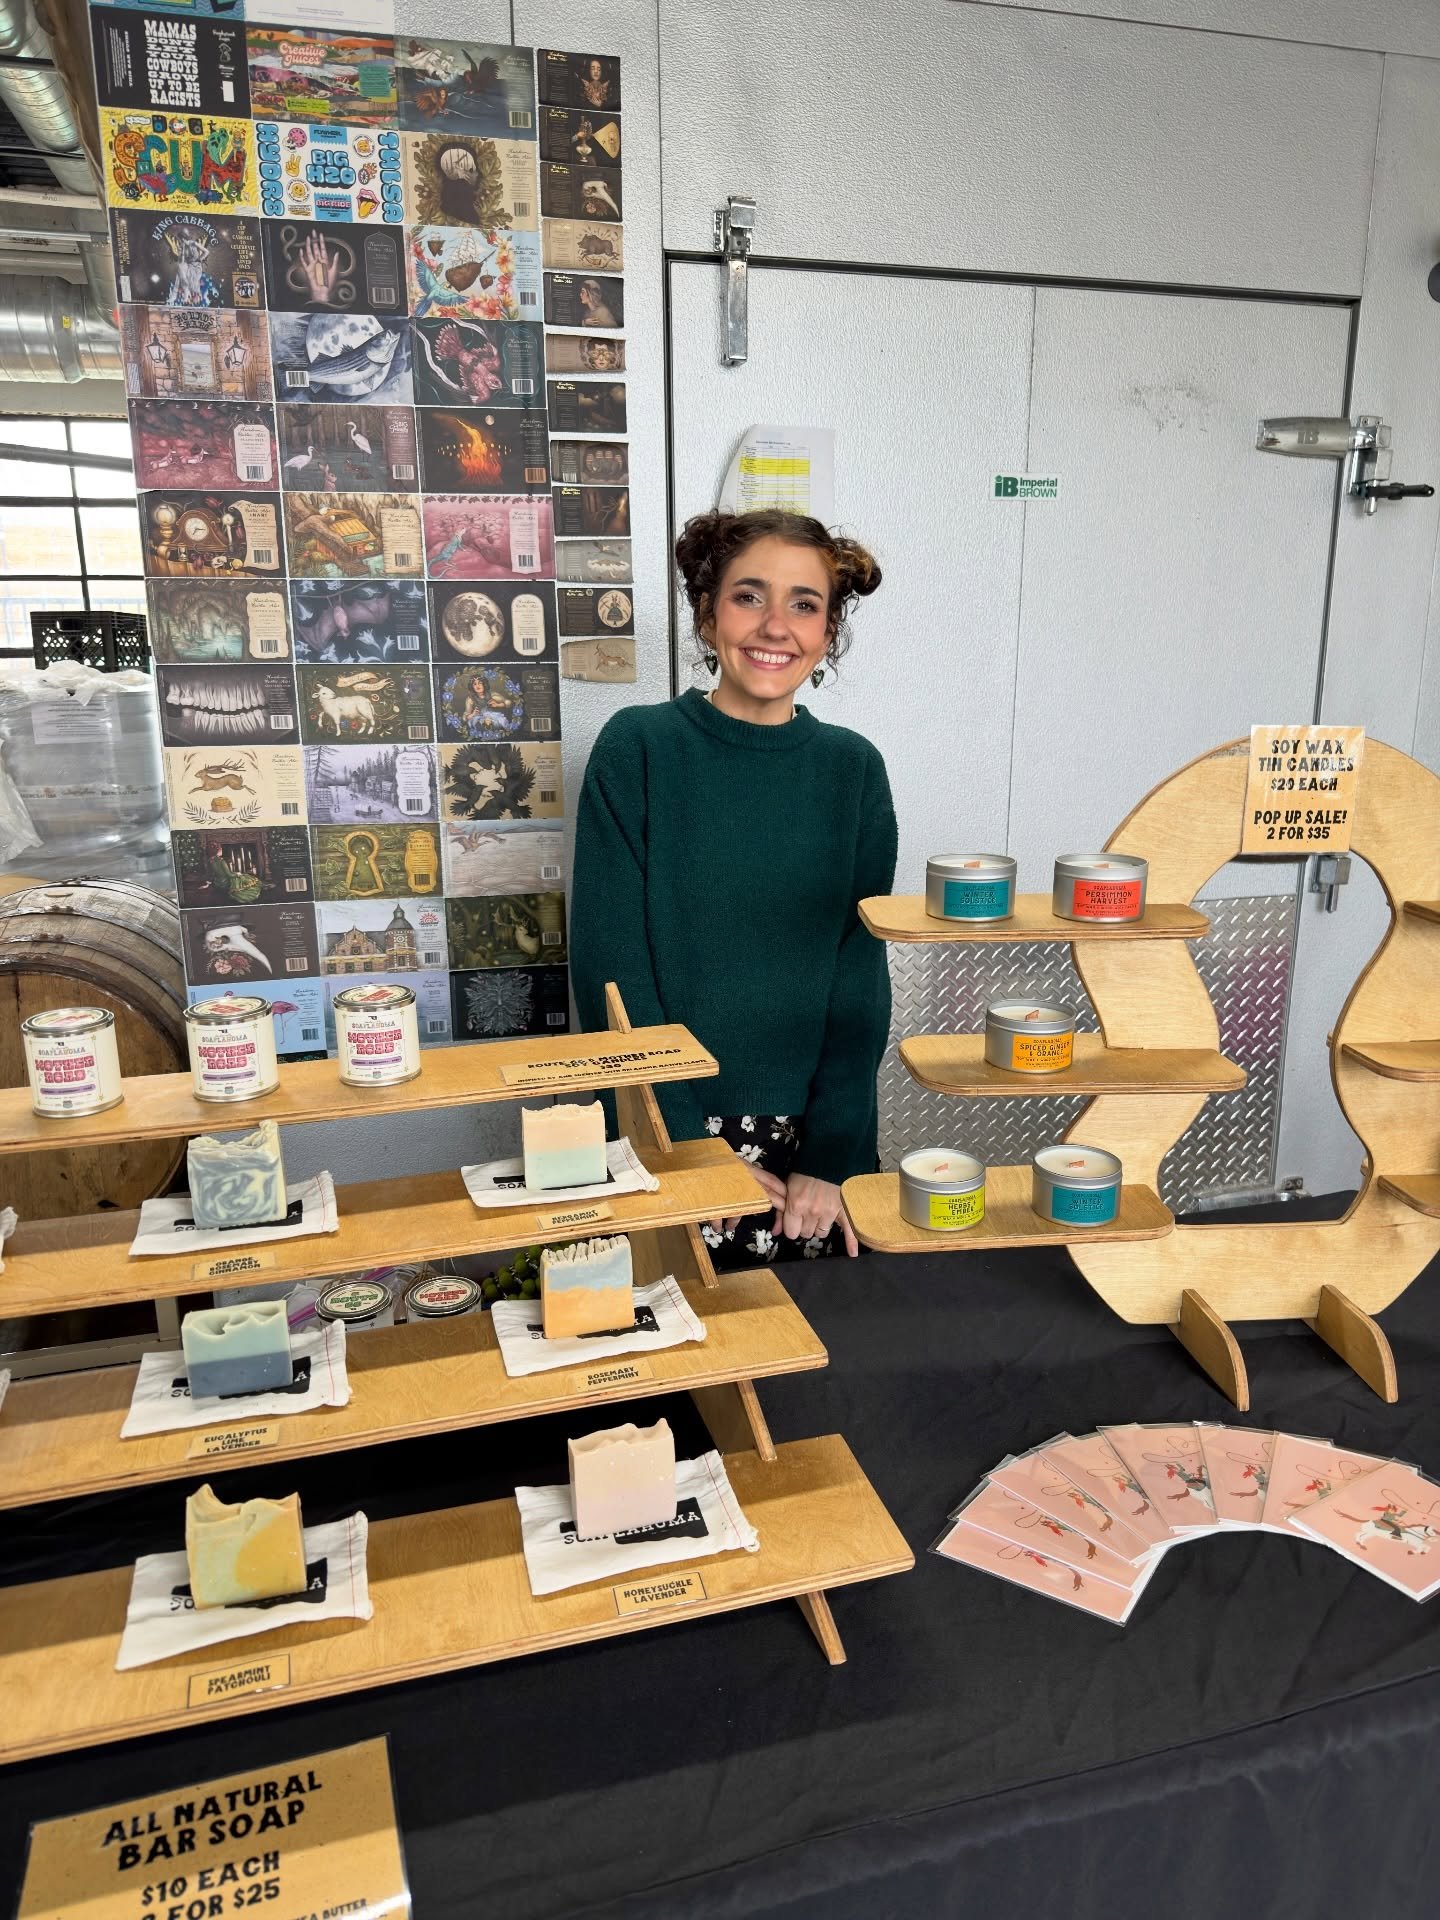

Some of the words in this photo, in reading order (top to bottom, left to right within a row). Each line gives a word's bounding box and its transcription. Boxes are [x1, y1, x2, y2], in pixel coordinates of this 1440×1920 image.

[144, 20, 197, 40] MAMAS
[146, 44, 195, 54] LET
[146, 50, 199, 61] YOUR
[280, 42, 327, 58] Creative
[147, 58, 199, 74] COWBOYS
[148, 71, 199, 82] GROW
[149, 79, 165, 90] UP
[168, 80, 183, 91] TO
[186, 82, 200, 92] BE
[150, 89, 201, 108] RACISTS
[311, 149, 350, 166] BIG
[152, 217, 173, 241] KING
[175, 215, 219, 246] CABBAGE
[1020, 477, 1058, 488] Imperial
[1020, 488, 1057, 498] BROWN
[1272, 740, 1300, 754] SOY
[1305, 740, 1344, 754] WAX
[1259, 757, 1282, 772] TIN
[1286, 757, 1354, 772] CANDLES
[1299, 778, 1338, 791] EACH
[1254, 810, 1281, 824] POP
[1285, 810, 1302, 824] UP
[1305, 810, 1348, 824] SALE!
[1267, 827, 1275, 840] 2
[1279, 827, 1304, 840] FOR
[1308, 827, 1330, 840] $35
[598, 1052, 646, 1060] MOTHER
[949, 1202, 970, 1210] HERBS
[588, 1366, 634, 1380] ROSEMARY
[588, 1371, 638, 1385] PEPPERMINT
[204, 1428, 268, 1443] EUCALYPTUS
[222, 1437, 245, 1445] LIME
[207, 1440, 260, 1453] LAVENDER
[624, 1578, 693, 1598] HONEYSUCKLE
[634, 1588, 686, 1604] LAVENDER
[208, 1664, 271, 1687] SPEARMINT
[208, 1673, 270, 1695] PATCHOULI
[102, 1811, 162, 1847] ALL
[174, 1770, 322, 1827] NATURAL
[117, 1828, 196, 1871] BAR
[209, 1800, 305, 1845] SOAP
[141, 1876, 187, 1906] $10
[198, 1850, 280, 1891] EACH
[167, 1895, 223, 1920] FOR
[233, 1877, 280, 1909] $25
[322, 1898, 367, 1920] BUTTER
